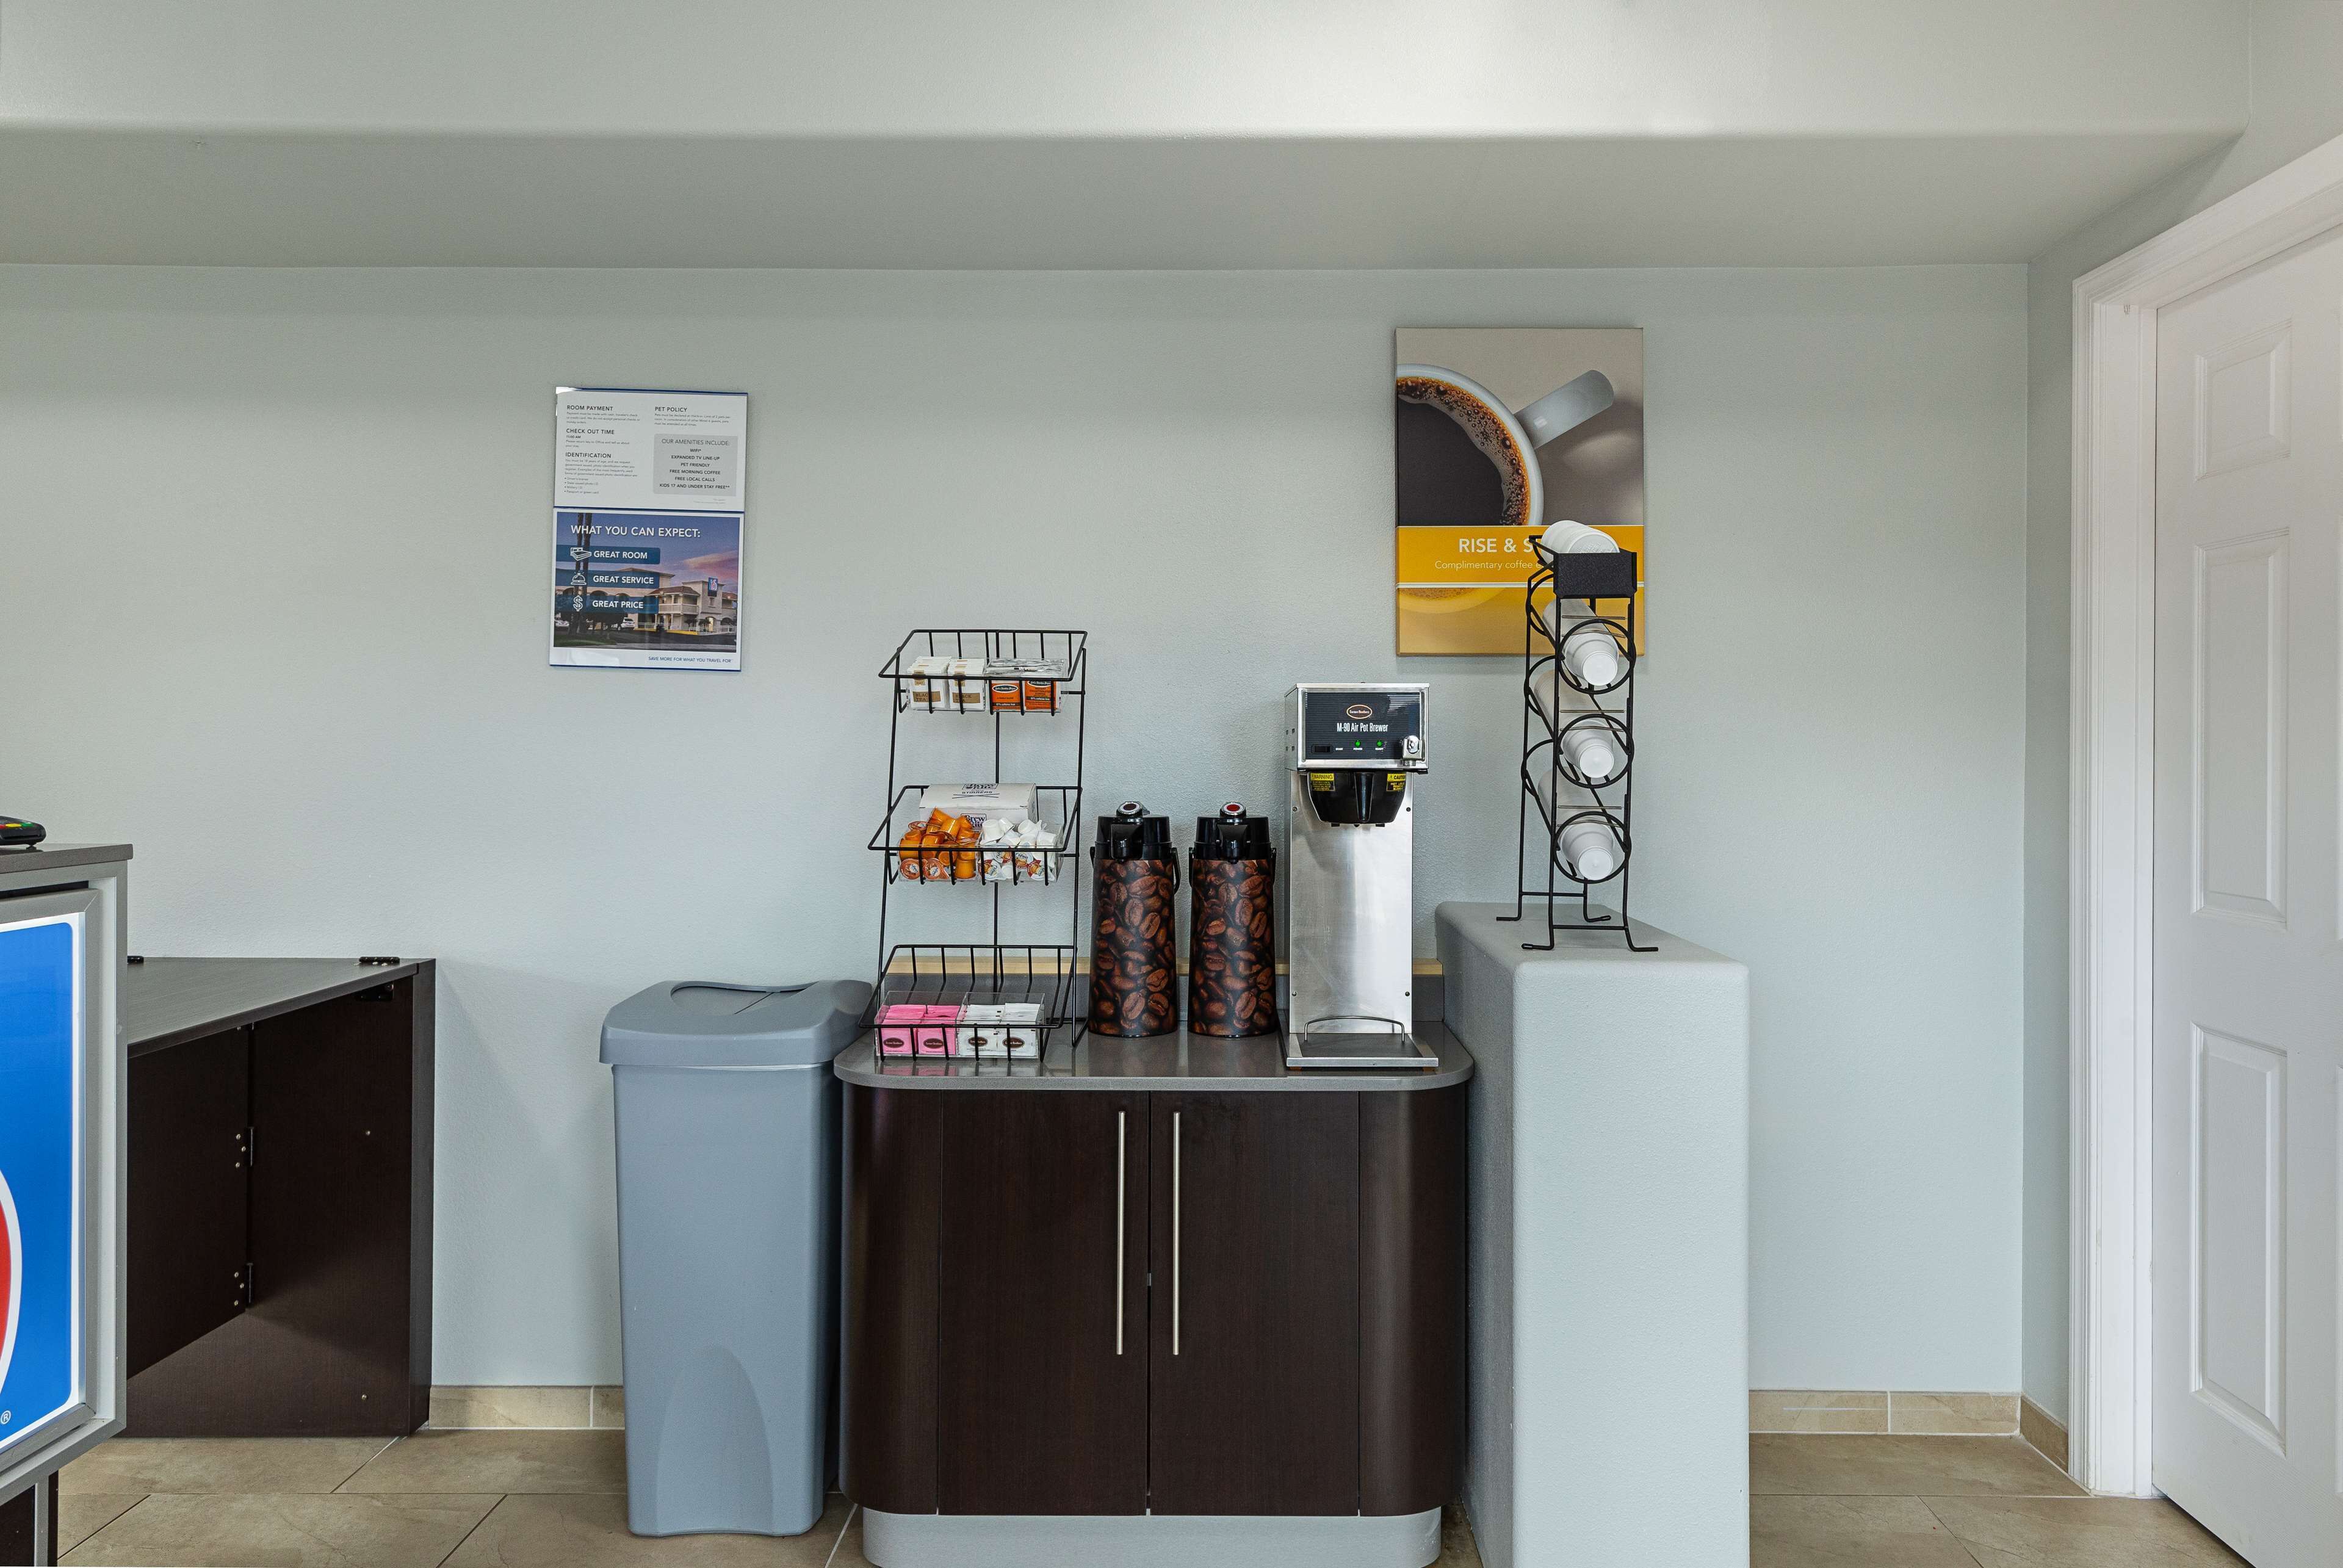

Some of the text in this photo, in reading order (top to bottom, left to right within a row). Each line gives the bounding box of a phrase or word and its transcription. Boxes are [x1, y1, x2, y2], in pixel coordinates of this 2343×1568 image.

[571, 525, 701, 538] WHAT YOU CAN EXPECT:
[1459, 538, 1497, 553] RISE
[1503, 538, 1517, 553] &
[622, 551, 648, 560] ROOM
[1435, 560, 1503, 571] Complimentary
[1505, 560, 1533, 568] coffee
[1337, 722, 1388, 732] M-90 Air Pot Brewer
